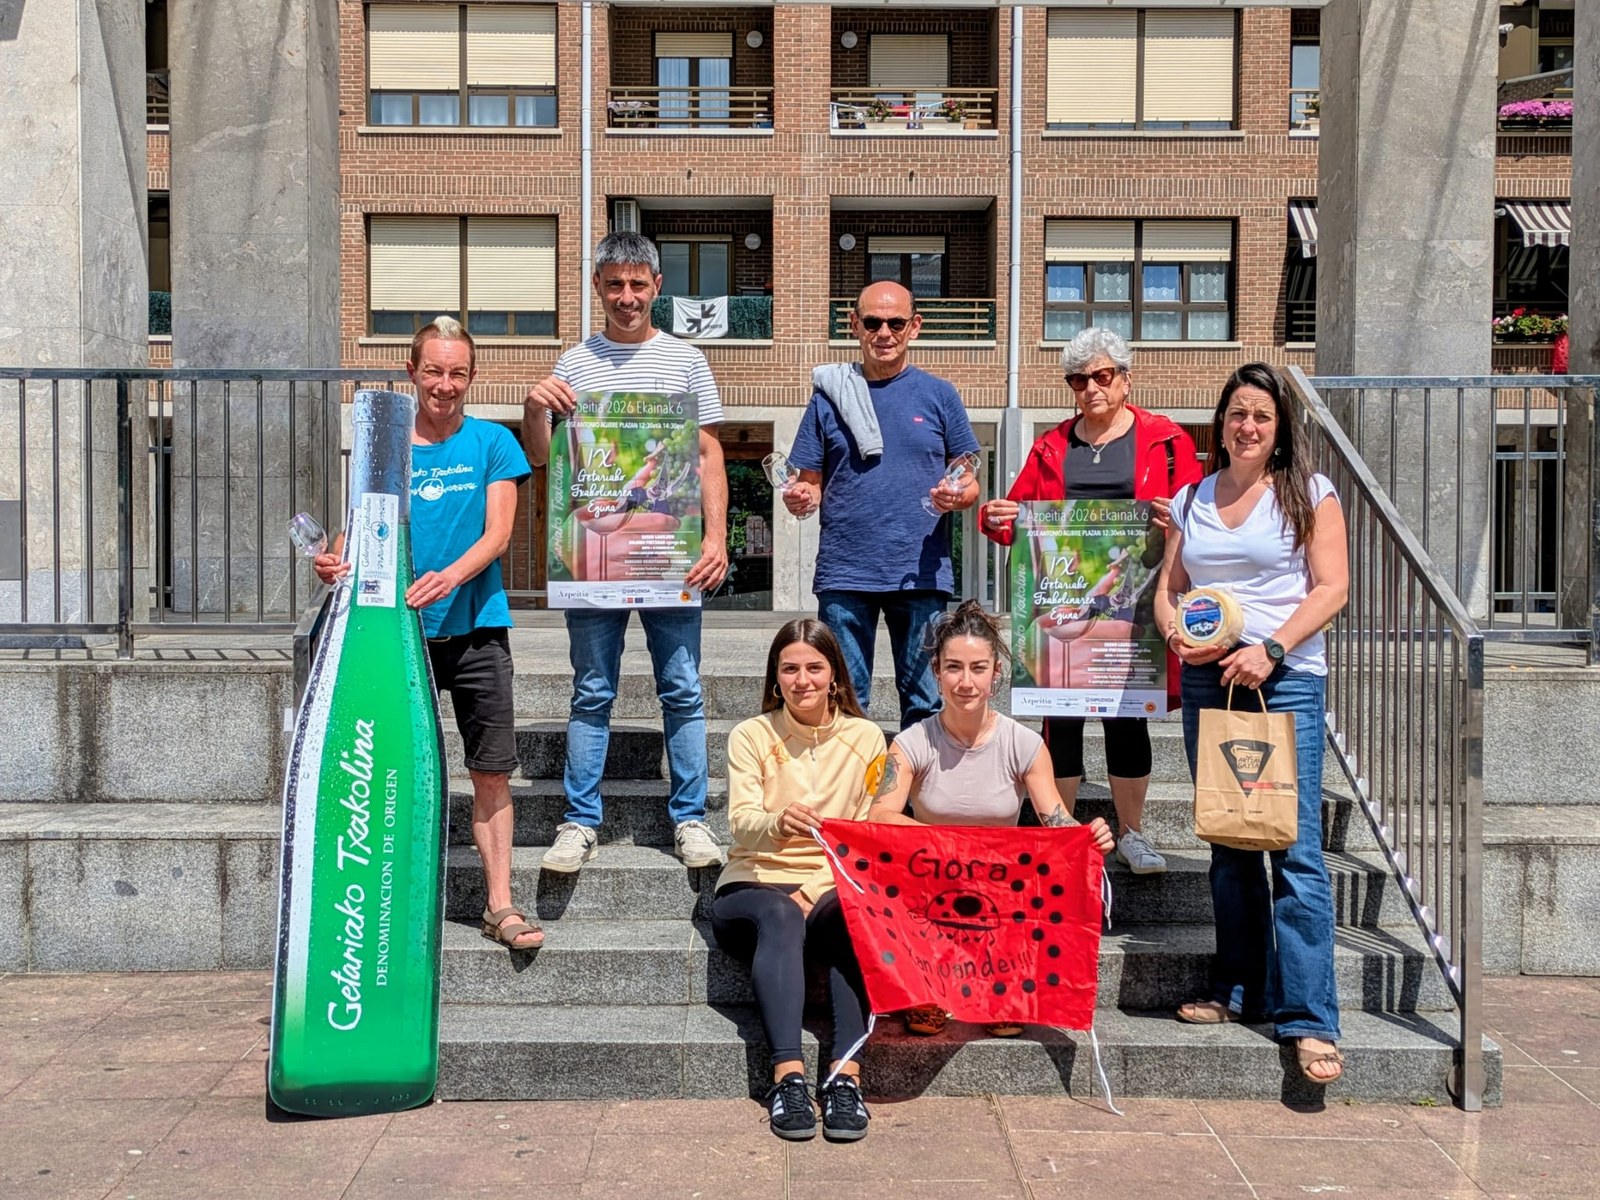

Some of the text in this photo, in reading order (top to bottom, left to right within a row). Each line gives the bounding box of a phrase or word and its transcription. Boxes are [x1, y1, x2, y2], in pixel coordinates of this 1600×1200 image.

[575, 400, 684, 415] peitia 2026 Ekainak 6
[587, 499, 617, 518] Eguna
[1027, 508, 1149, 523] Azpeitia 2026 Ekainak 6
[1050, 607, 1080, 625] Eguna
[327, 717, 375, 1031] Getariako Txakolina
[908, 848, 1008, 881] Gora
[376, 768, 398, 987] DENOMINACION DE ORIGEN
